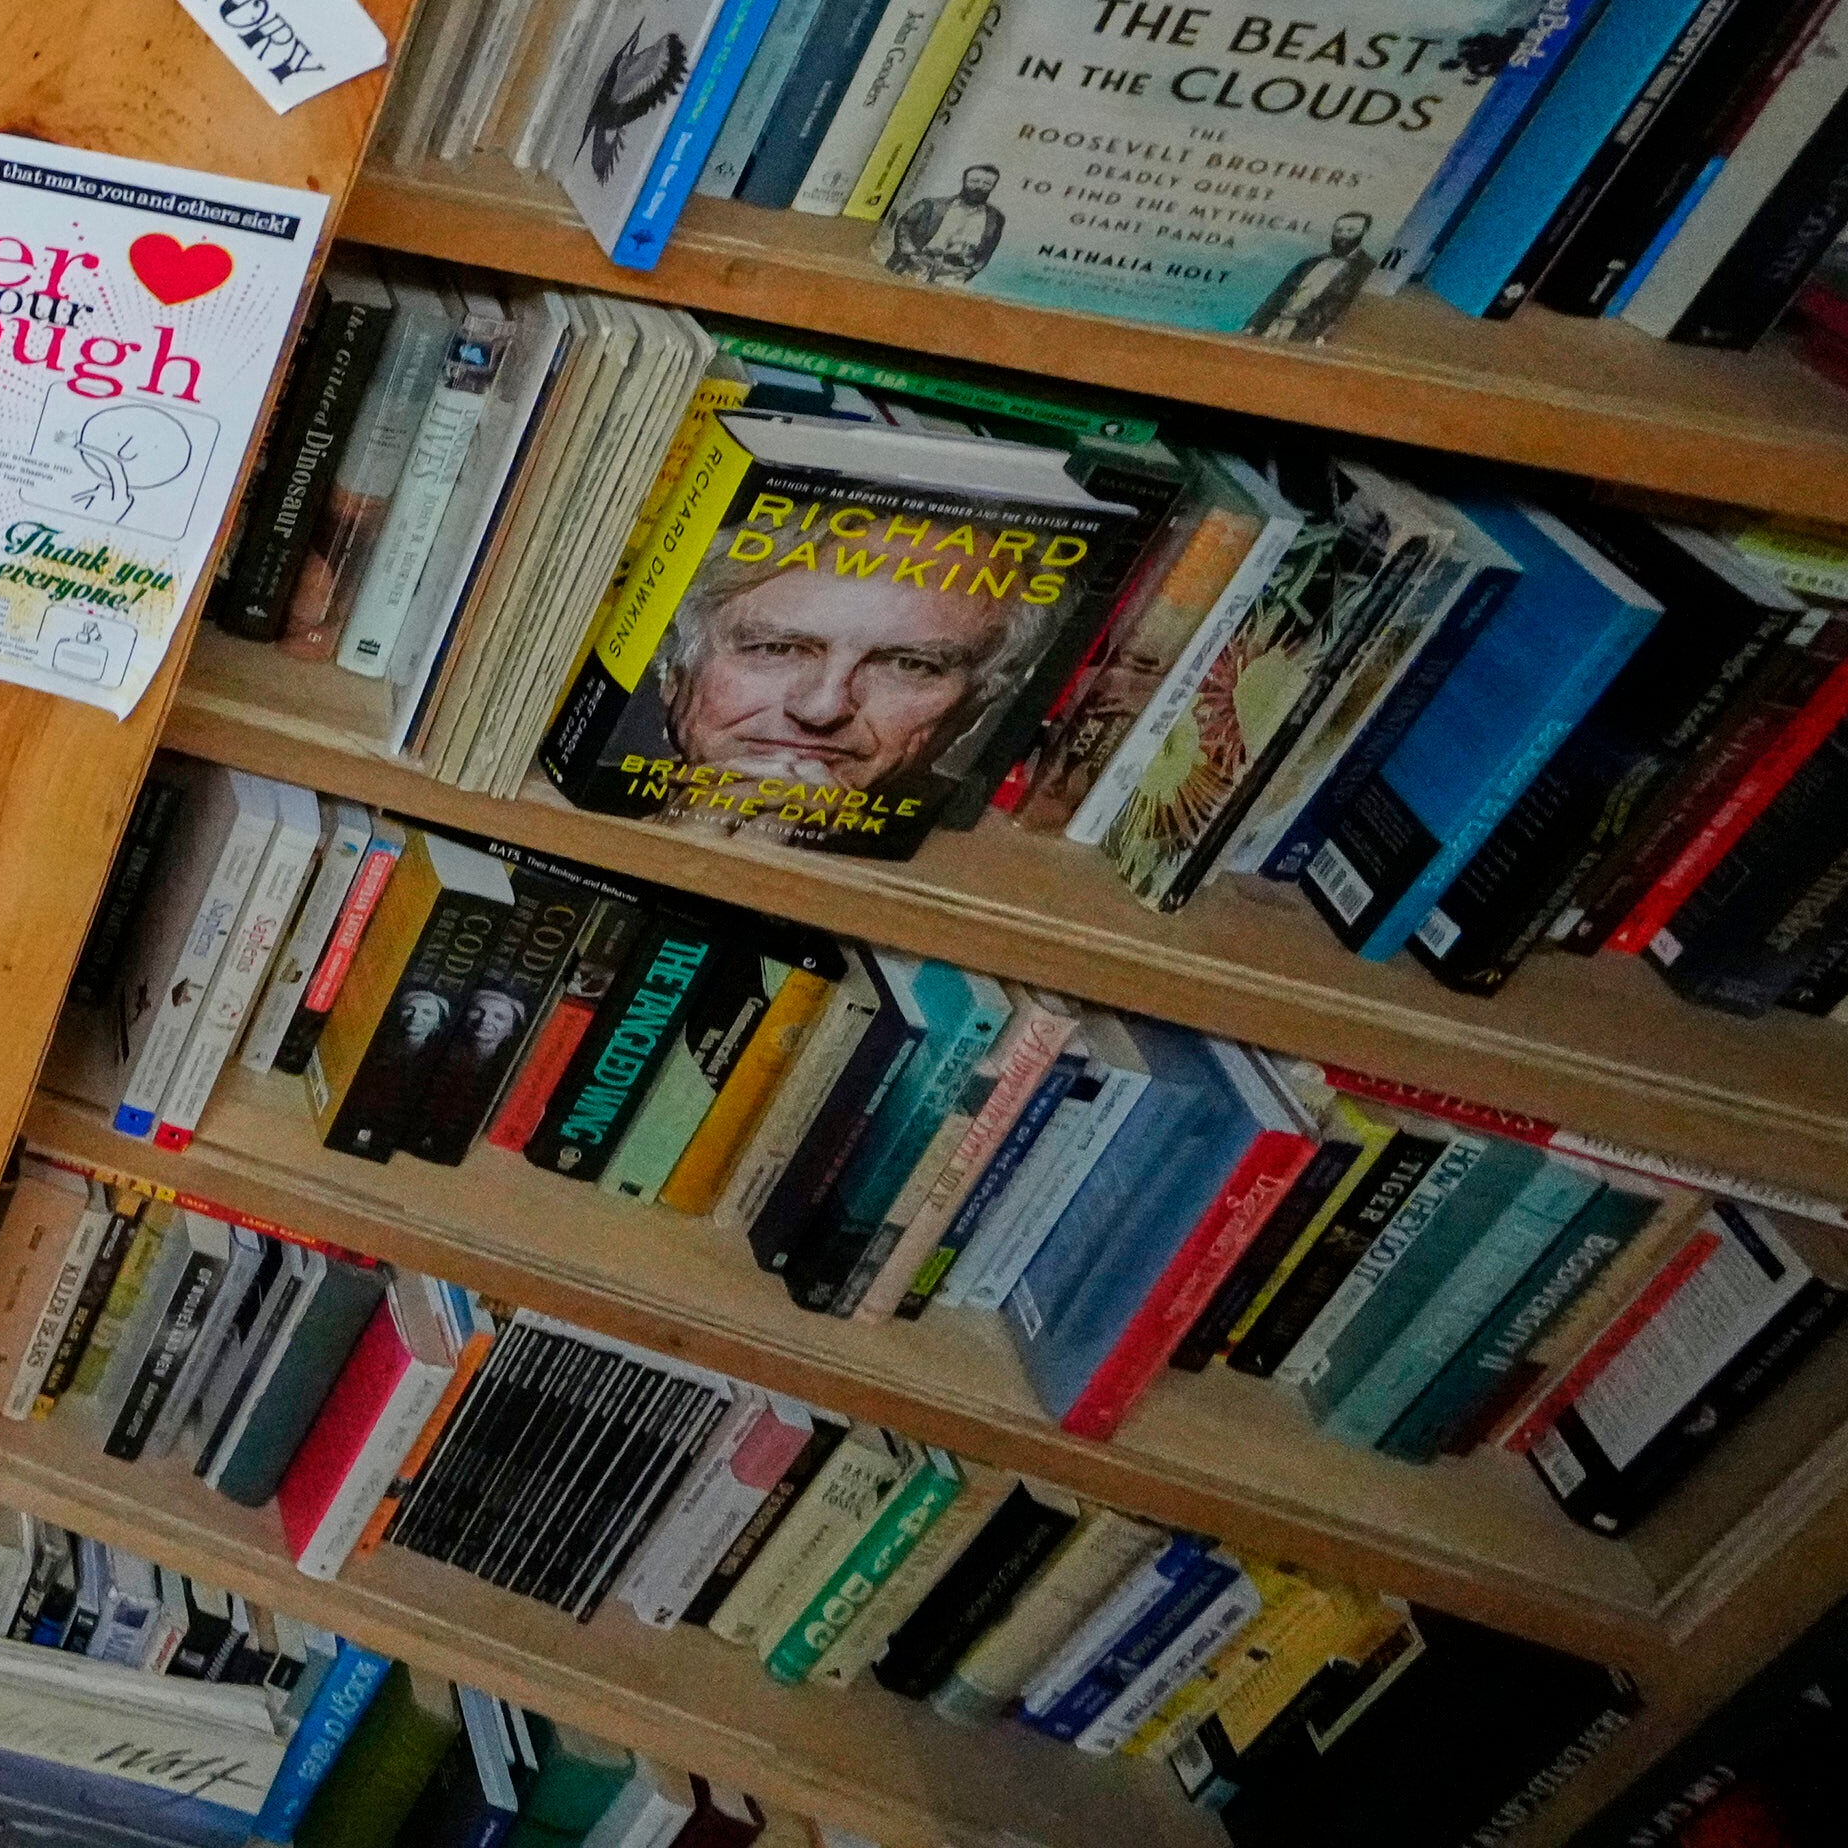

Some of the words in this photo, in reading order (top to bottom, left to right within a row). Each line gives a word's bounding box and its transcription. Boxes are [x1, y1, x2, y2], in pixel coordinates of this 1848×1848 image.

[934, 1, 1005, 126] CLOUDS
[1228, 15, 1442, 77] BEAST
[1017, 54, 1064, 82] IN
[1080, 63, 1153, 97] THE
[1171, 65, 1444, 133] CLOUDS
[1017, 123, 1191, 165] ROOSEVELT
[3, 161, 43, 185] that
[45, 174, 97, 196] make
[97, 185, 135, 203] you
[136, 191, 176, 213] and
[176, 198, 241, 225] others
[240, 214, 291, 236] sick!
[1019, 178, 1052, 197] TO
[1064, 185, 1122, 207] FIND
[1134, 195, 1179, 215] THE
[1189, 204, 1313, 236] MYTHICAL
[1085, 162, 1180, 190] DEADLY
[1193, 177, 1277, 203] QUEST
[1037, 243, 1155, 276] NATHALIA
[1164, 260, 1234, 286] HOLT
[1069, 211, 1144, 235] GIANT
[1155, 225, 1238, 250] PANDA
[341, 304, 370, 344] the
[311, 347, 353, 426] Gilded
[408, 399, 463, 485] LIVES
[270, 427, 332, 542] Dinosaur
[659, 444, 726, 555] RICHARD
[765, 477, 809, 494] AUTHOR
[812, 484, 828, 495] OF
[829, 487, 844, 498] AN
[846, 489, 900, 508] APPETITE
[902, 498, 924, 511] FOR
[927, 501, 973, 518] WONDER
[1001, 511, 1024, 524] THE
[1025, 514, 1070, 531] SELFISH
[1072, 518, 1102, 534] GENE
[4, 520, 110, 574] Thank
[108, 560, 174, 592] you
[746, 492, 1089, 568] RICHARD
[727, 530, 1067, 605] DAWKINS
[605, 555, 669, 658] DAWKINS
[582, 679, 609, 717] BRIEF
[557, 718, 590, 764] CANDLE
[619, 754, 752, 791] BRIEF
[757, 775, 923, 819] CANDLE
[624, 776, 670, 801] IN
[686, 784, 771, 819] THE
[777, 798, 888, 835] DARK
[487, 841, 522, 863] BATS
[525, 854, 548, 871] Their
[547, 862, 581, 885] Biology
[581, 875, 600, 890] and
[599, 881, 640, 905] Behavior
[231, 911, 277, 978] Sapiens
[427, 908, 499, 998] CODE
[509, 899, 577, 995] CODE
[658, 938, 707, 993] THE
[595, 976, 683, 1096] TANGLED
[565, 1077, 628, 1152] WING
[1356, 1155, 1421, 1227] TIGER
